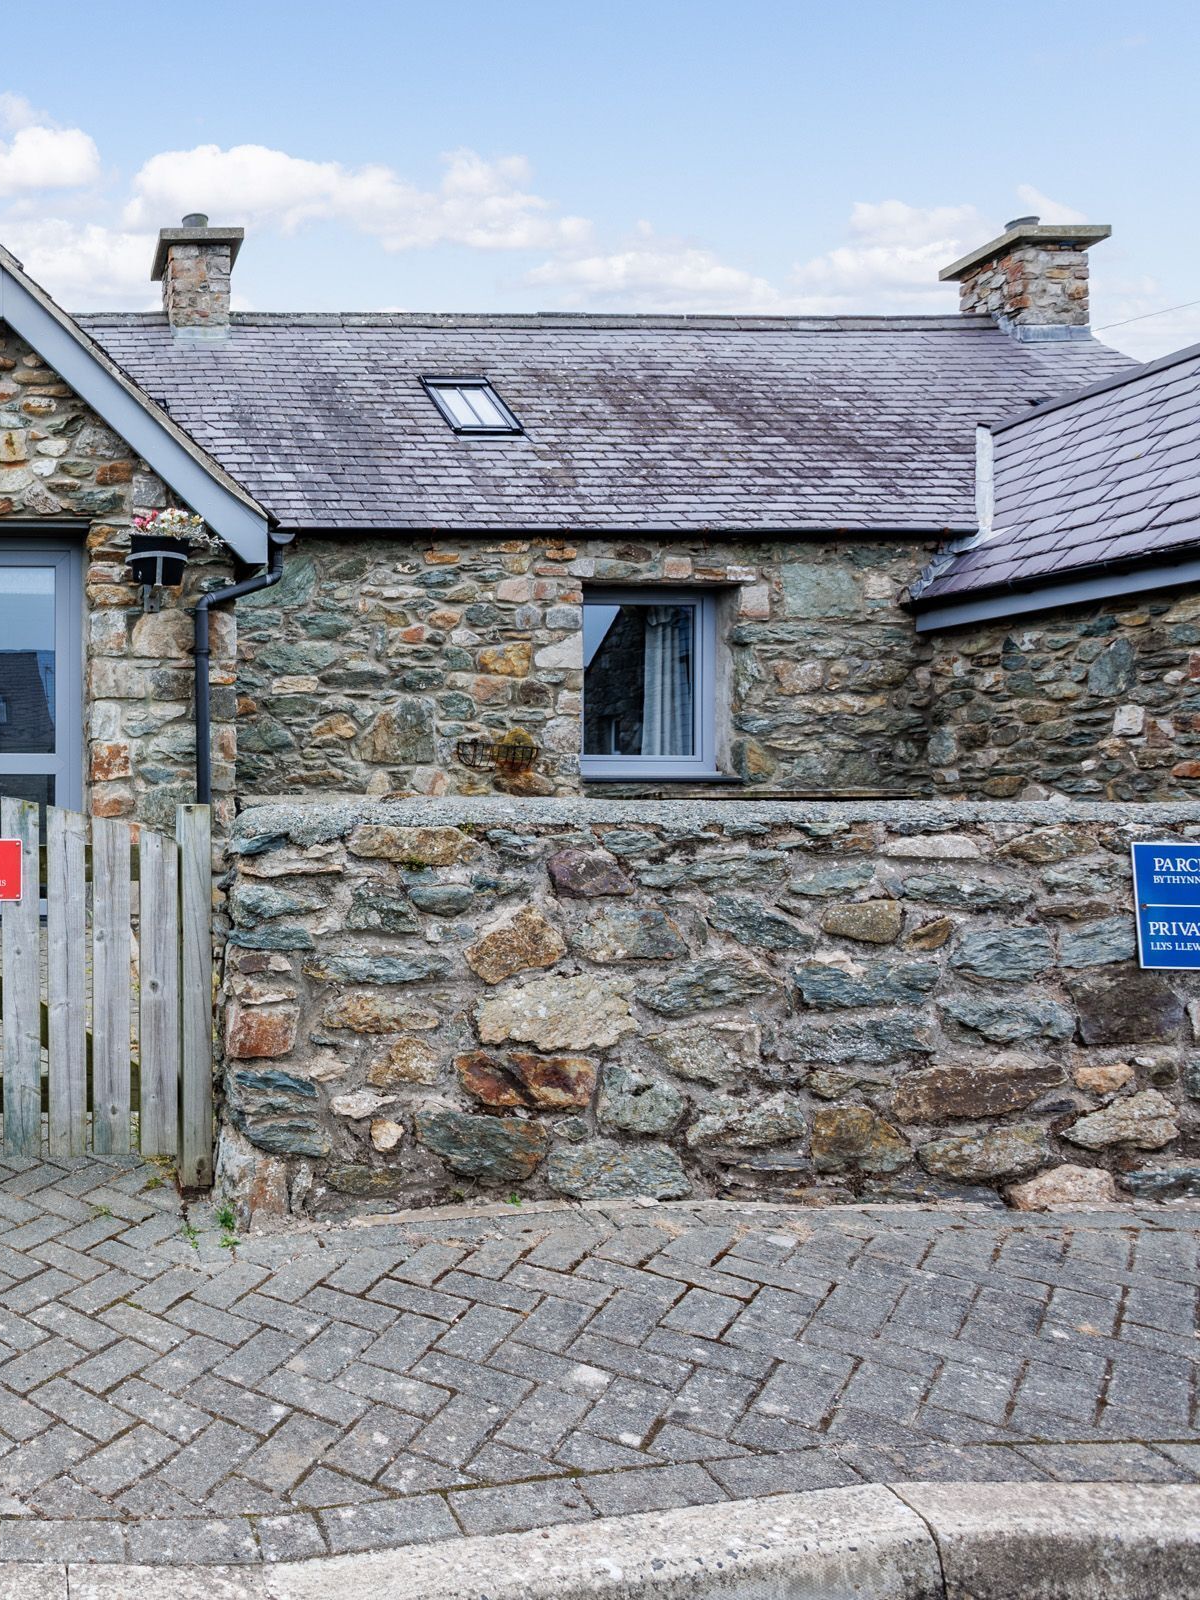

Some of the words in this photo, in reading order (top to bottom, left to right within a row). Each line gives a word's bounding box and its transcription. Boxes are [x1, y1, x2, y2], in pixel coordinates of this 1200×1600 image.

[1153, 857, 1200, 872] PARC
[1148, 921, 1200, 936] PRIVA
[1150, 941, 1173, 951] LLYS
